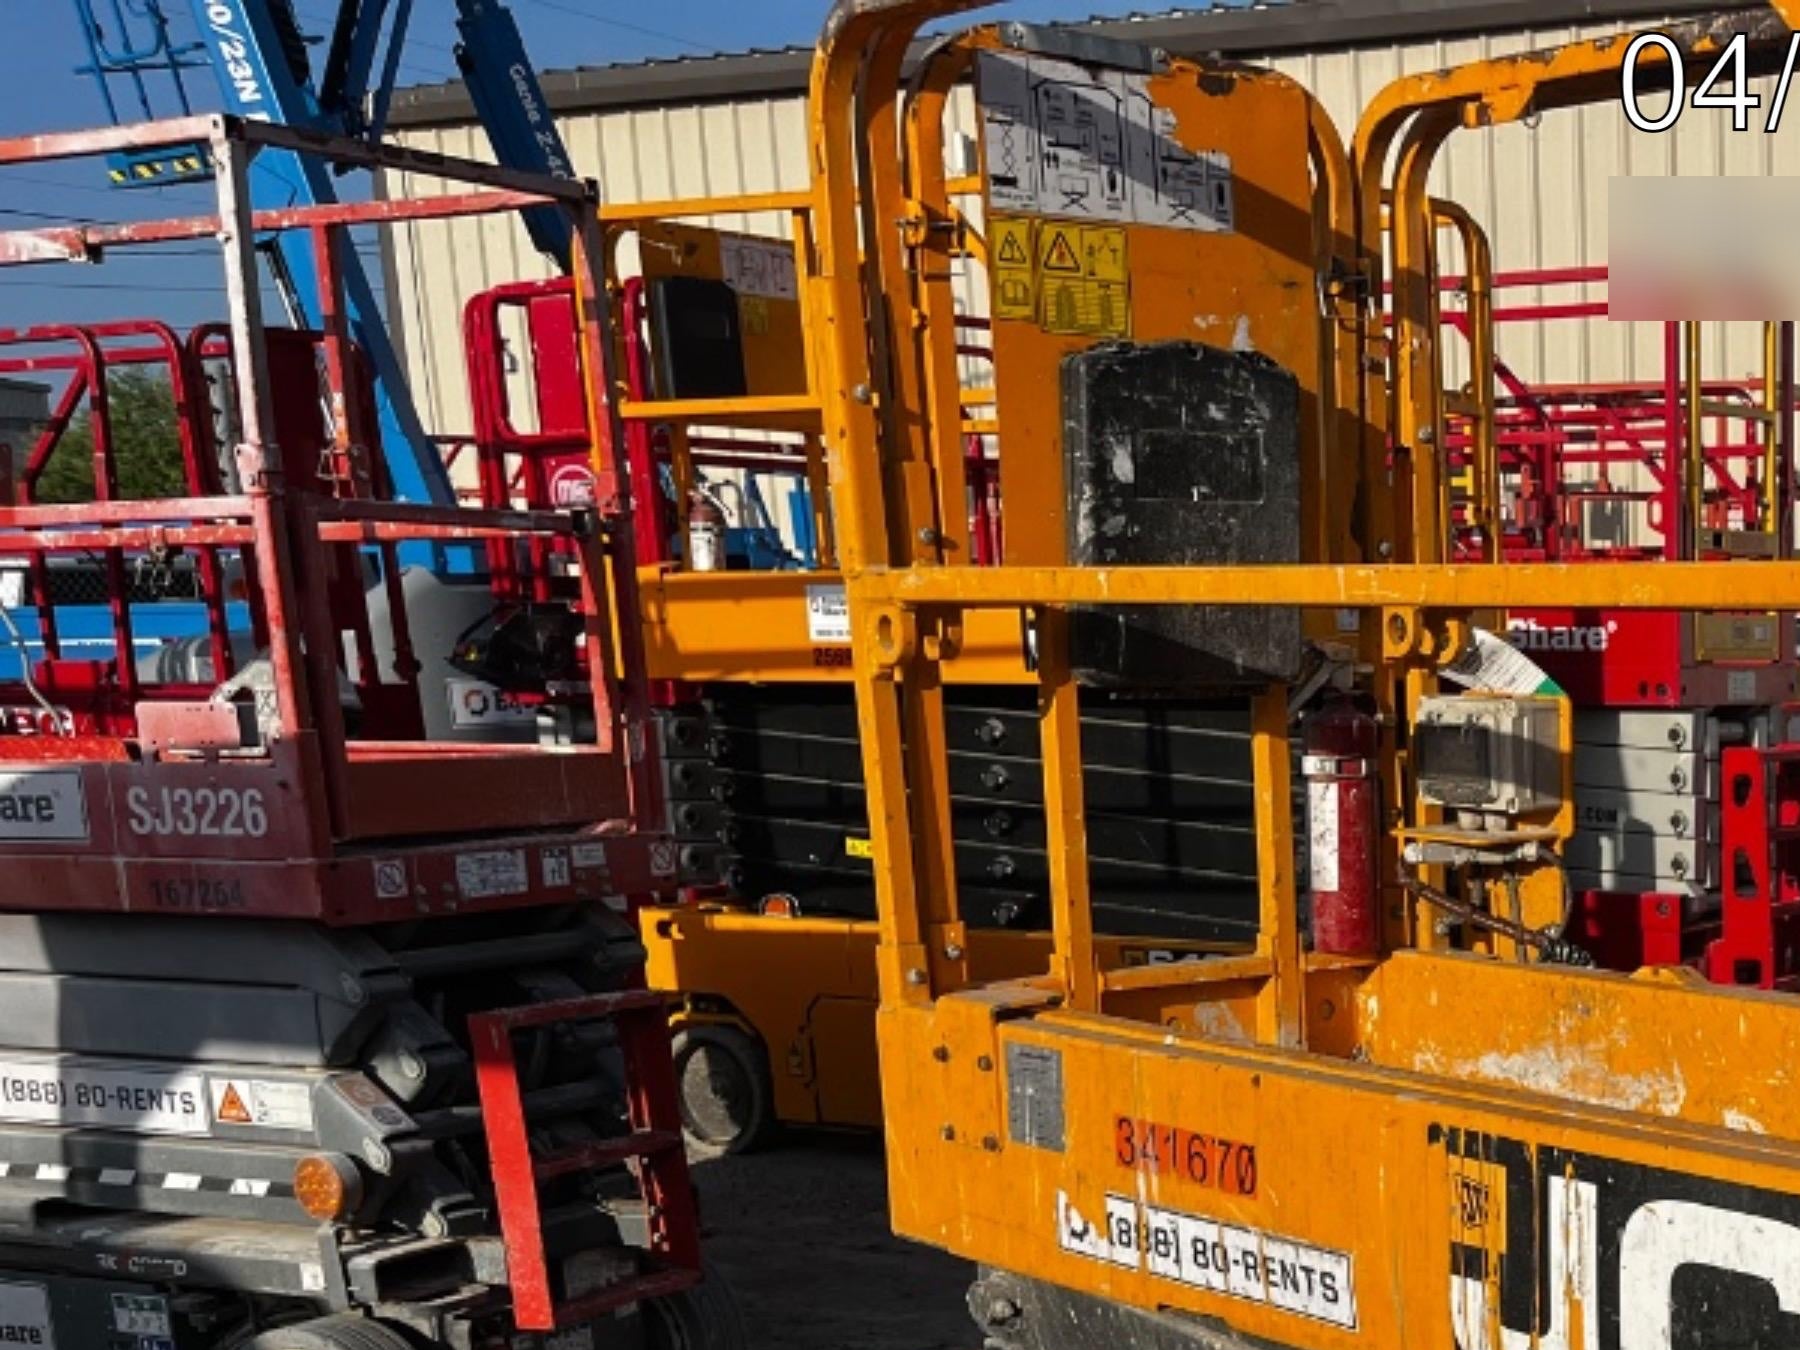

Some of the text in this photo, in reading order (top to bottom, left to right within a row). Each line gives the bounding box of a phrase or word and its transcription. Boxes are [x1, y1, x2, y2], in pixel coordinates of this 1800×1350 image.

[127, 785, 268, 838] SJ3226
[2, 1078, 196, 1116] (888) 80-RENTS
[1191, 1236, 1339, 1303] 80-RENTS
